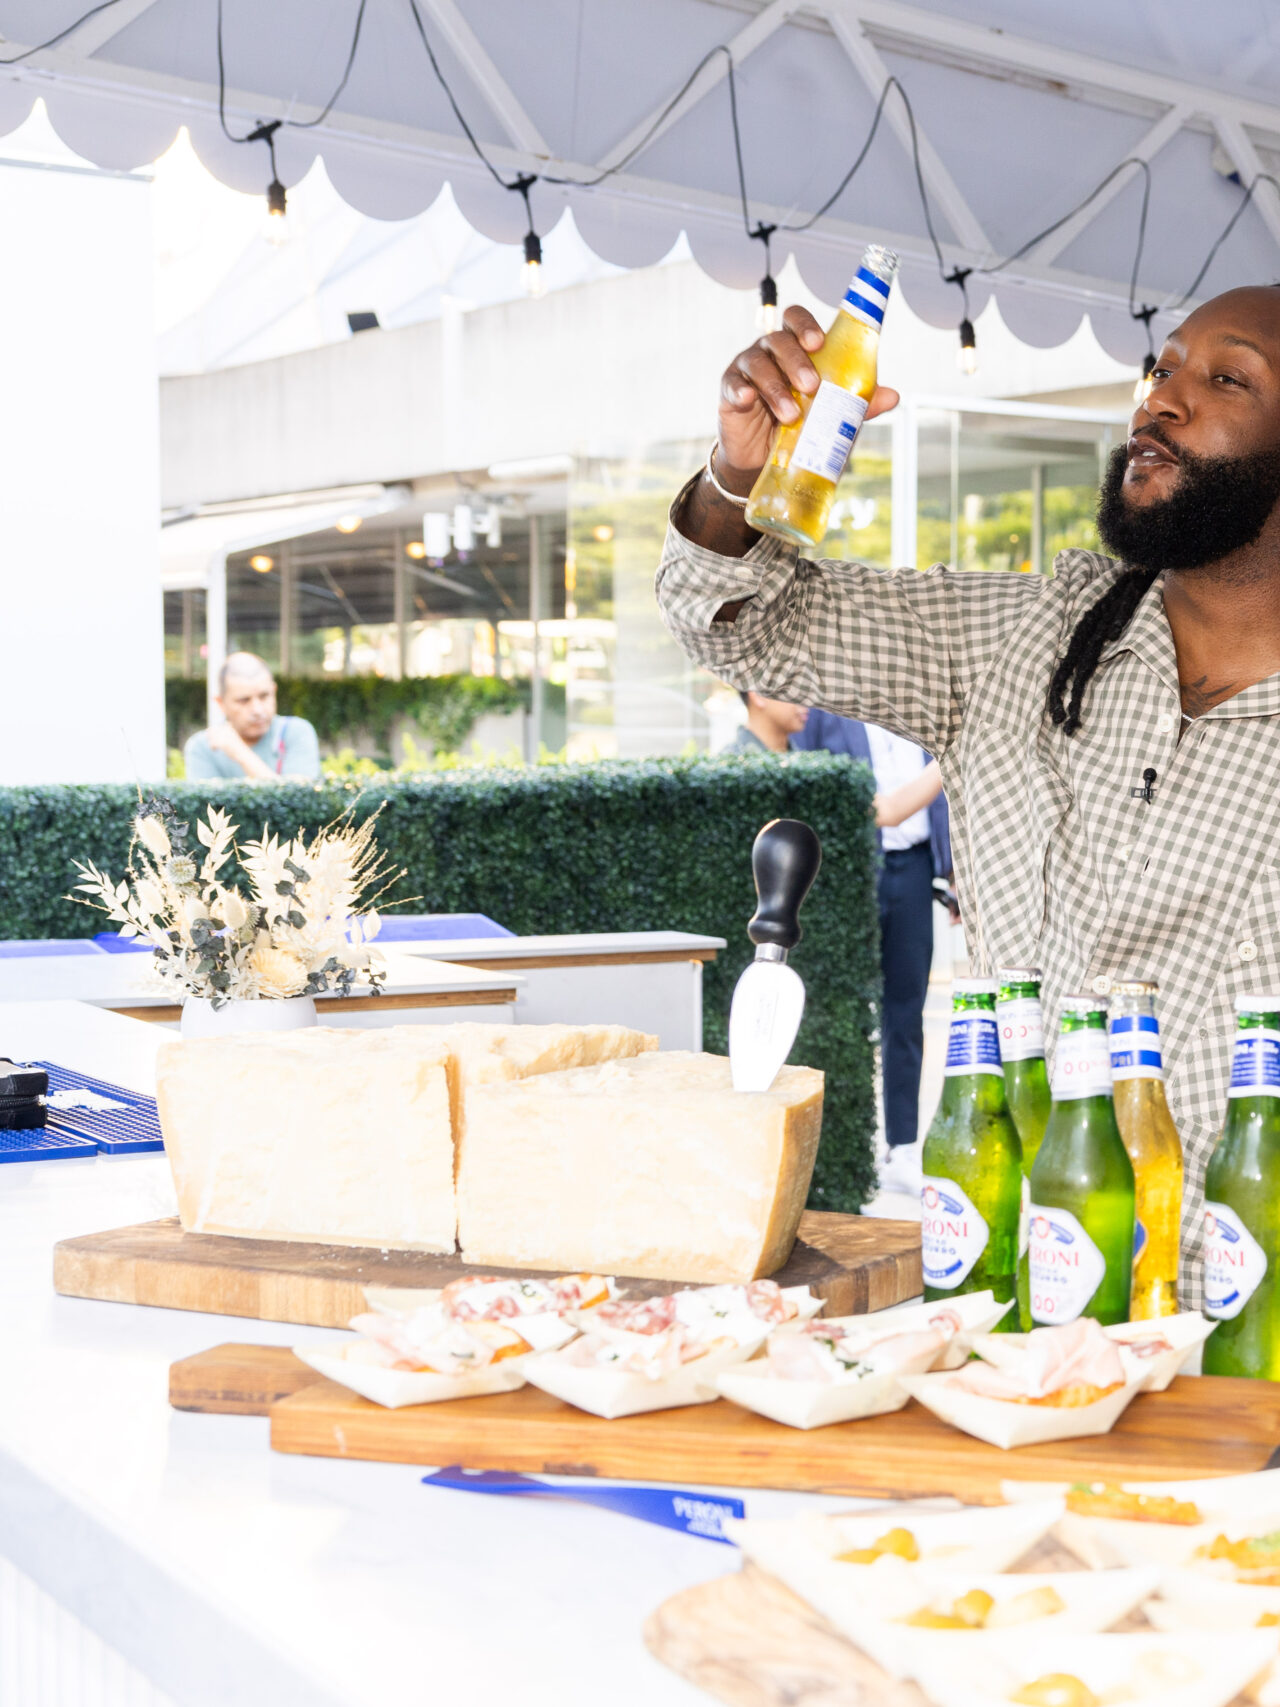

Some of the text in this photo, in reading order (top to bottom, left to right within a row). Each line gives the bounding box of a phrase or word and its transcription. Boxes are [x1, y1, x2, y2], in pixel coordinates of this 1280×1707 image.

[1111, 1054, 1132, 1067] PRI
[923, 1216, 968, 1237] RONI
[1029, 1245, 1079, 1267] RONI
